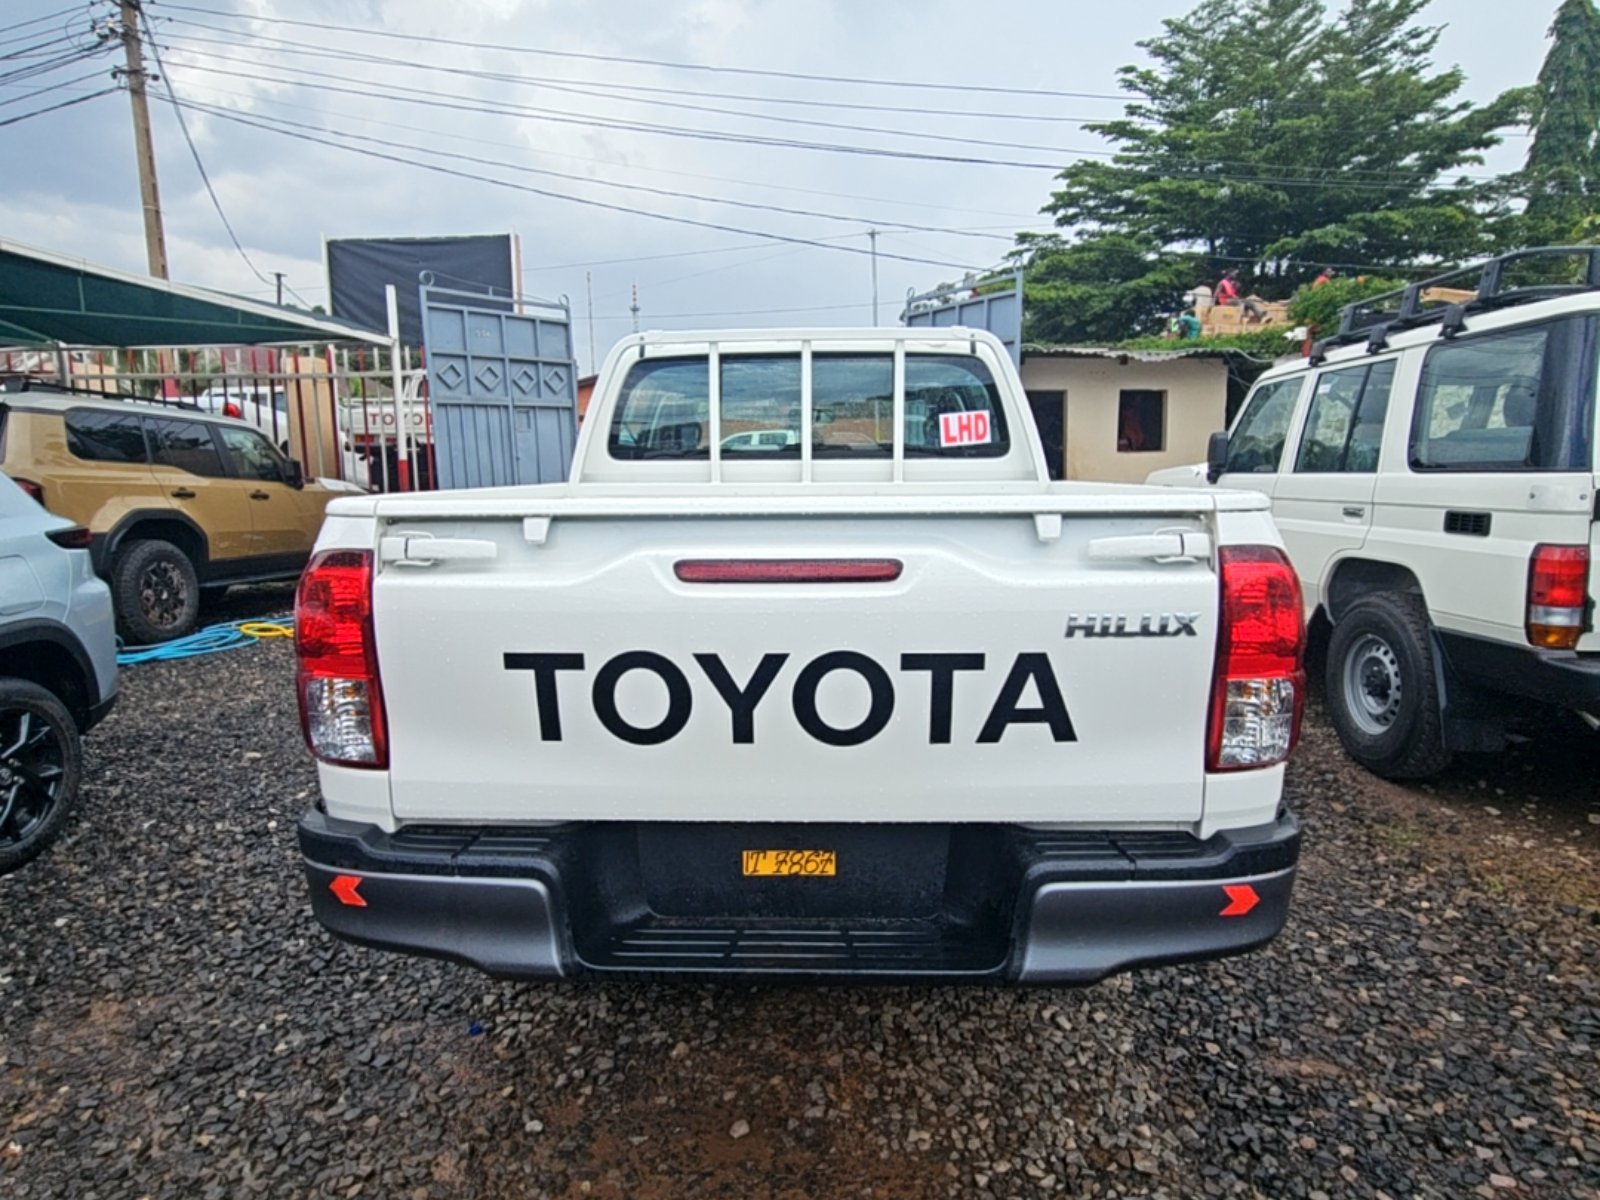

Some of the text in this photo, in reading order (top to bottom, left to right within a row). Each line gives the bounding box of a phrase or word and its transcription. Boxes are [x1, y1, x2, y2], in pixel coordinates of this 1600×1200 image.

[943, 413, 987, 443] LHD
[1064, 612, 1201, 638] HILUX
[503, 650, 1078, 746] TOYOTA
